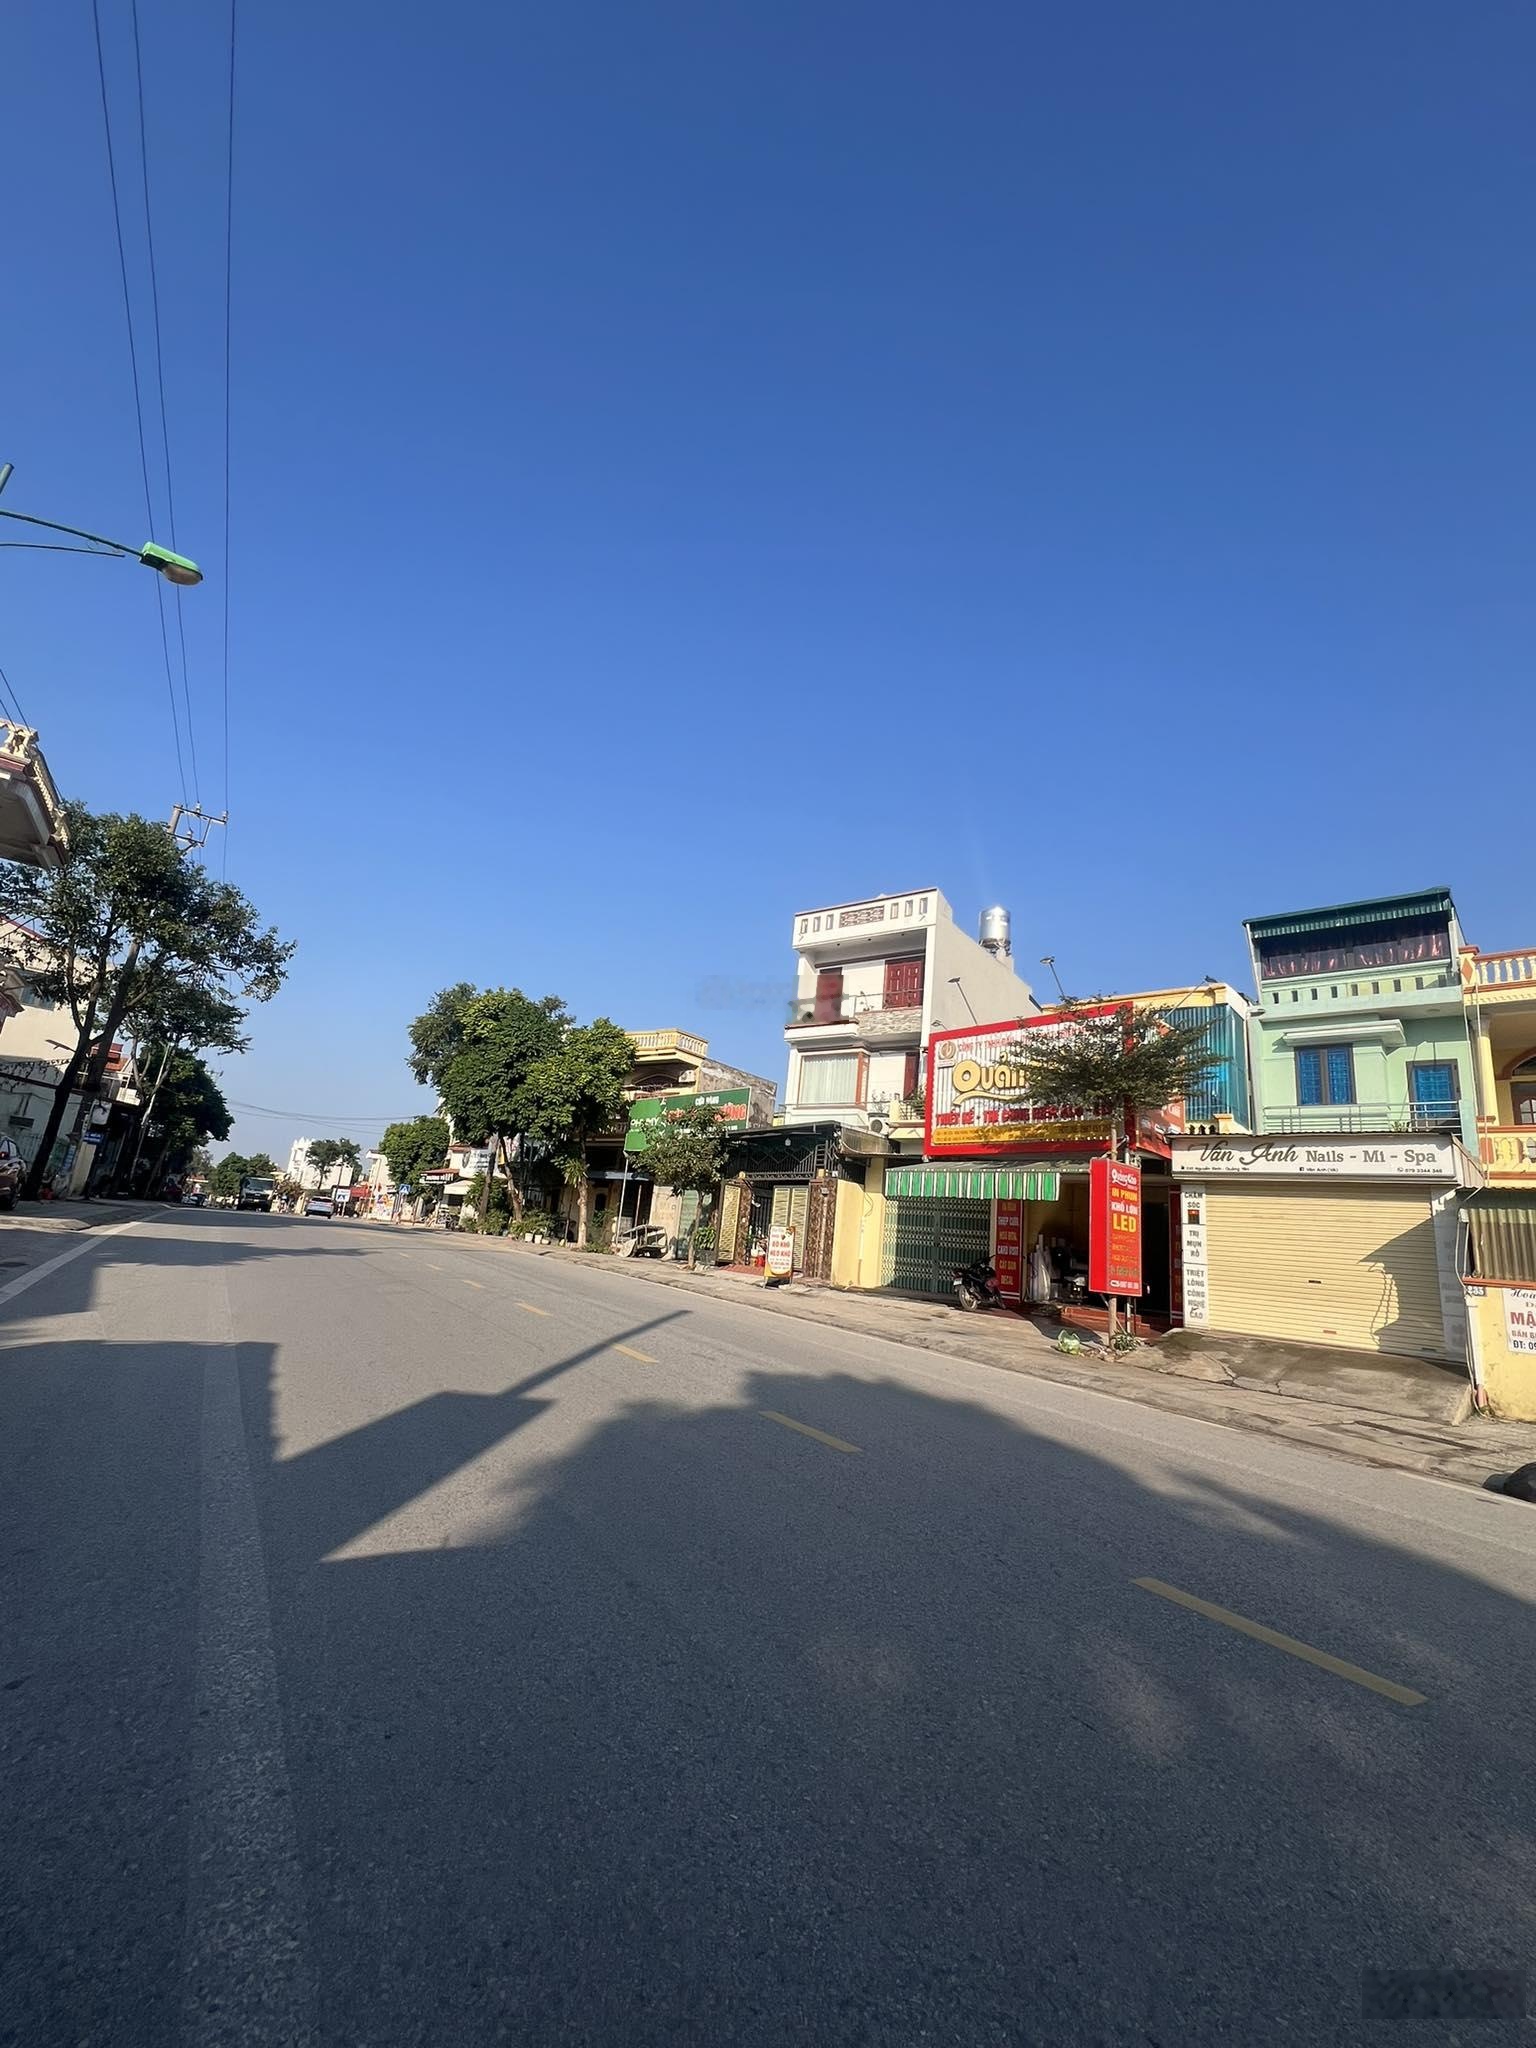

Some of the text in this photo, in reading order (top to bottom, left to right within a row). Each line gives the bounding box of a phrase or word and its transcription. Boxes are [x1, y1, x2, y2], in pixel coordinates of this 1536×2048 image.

[1239, 1141, 1298, 1166] Anh
[1306, 1150, 1344, 1163] Nails
[1362, 1150, 1386, 1163] Mi
[1404, 1149, 1437, 1166] Spa
[1187, 1200, 1201, 1209] SÓC
[1113, 1213, 1137, 1233] LED
[1187, 1269, 1204, 1278] TRIỆT
[1187, 1289, 1206, 1298] CÔNG
